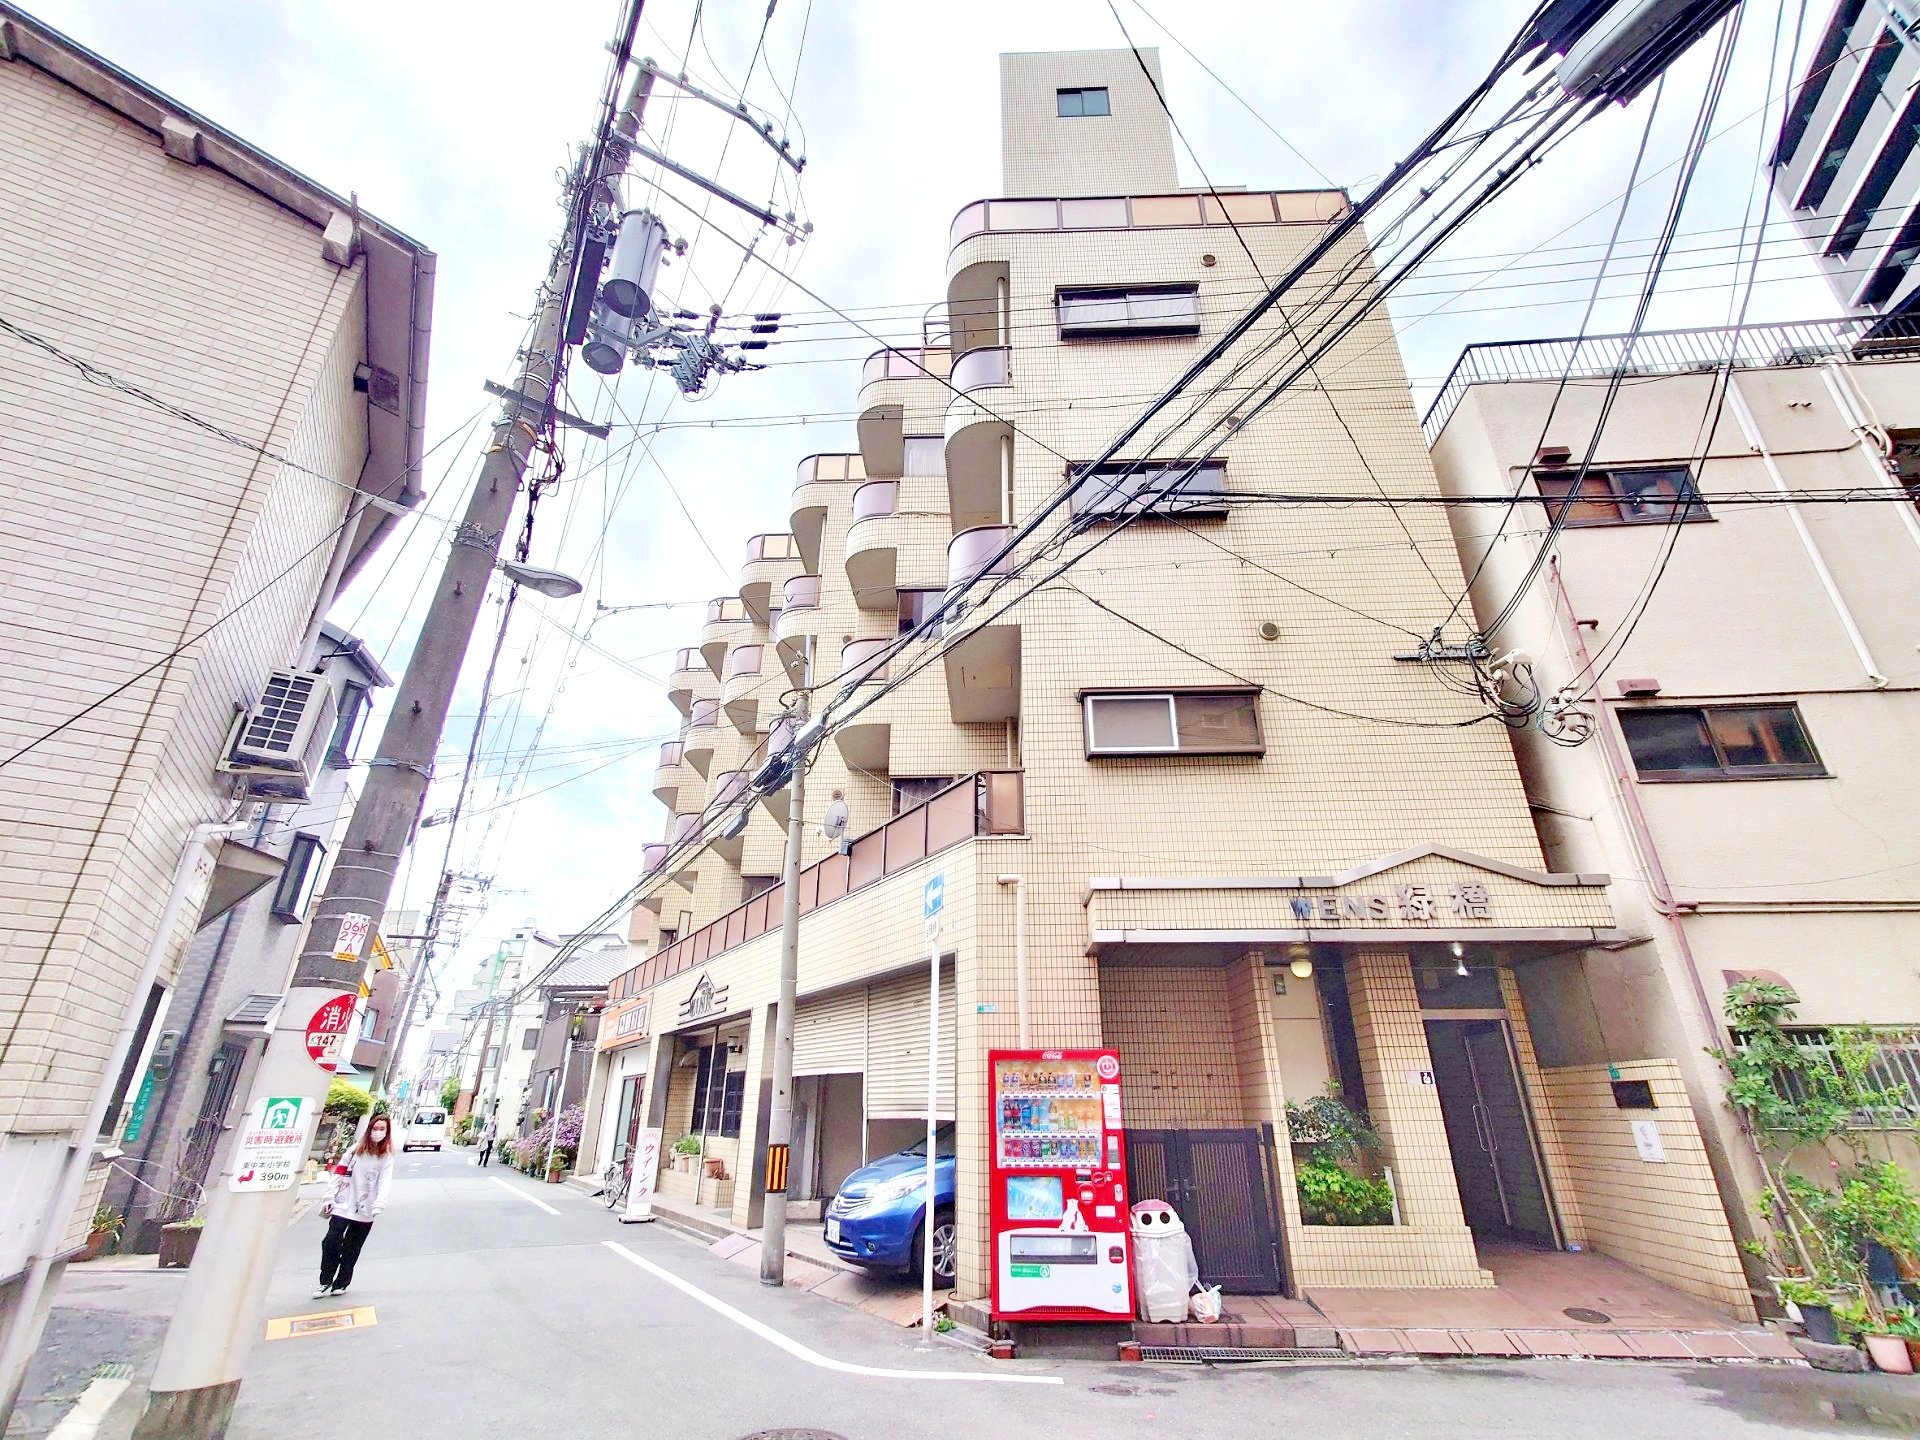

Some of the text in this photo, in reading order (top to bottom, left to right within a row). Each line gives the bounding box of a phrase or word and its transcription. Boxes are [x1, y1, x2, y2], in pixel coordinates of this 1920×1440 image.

[1288, 894, 1389, 920] WENS
[339, 931, 365, 943] 277
[259, 1172, 290, 1181] 390m
